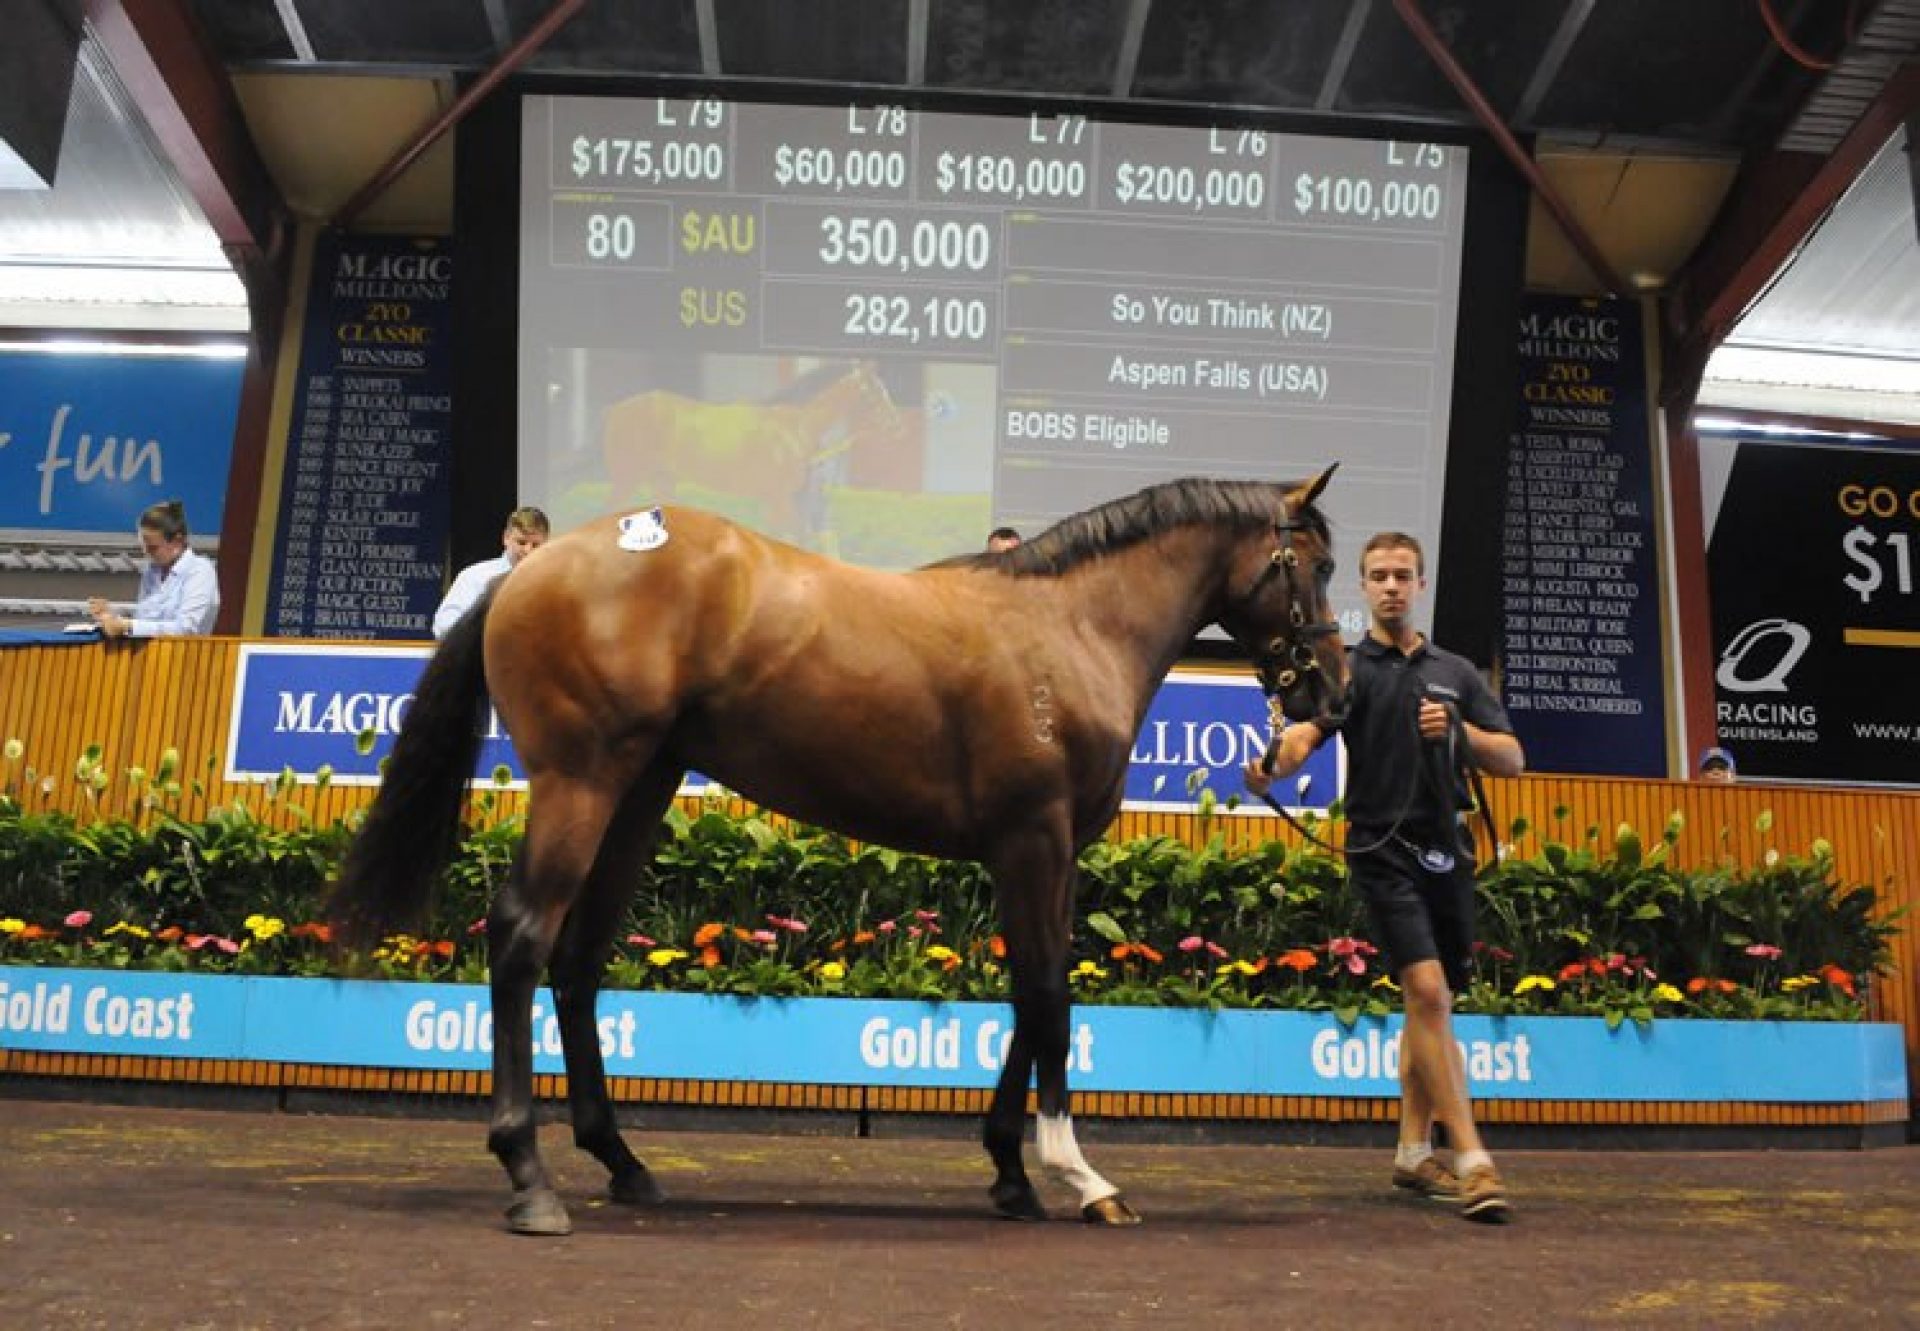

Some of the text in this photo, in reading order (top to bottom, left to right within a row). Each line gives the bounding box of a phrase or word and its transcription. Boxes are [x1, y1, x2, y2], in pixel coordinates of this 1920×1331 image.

[571, 135, 723, 184] $175,000
[774, 144, 905, 192] $60,000
[936, 151, 1085, 200] $180,000
[1115, 162, 1264, 210] $200,000
[1294, 173, 1441, 220] $100,000
[586, 214, 636, 260] 80
[681, 210, 756, 254] $AU
[819, 217, 990, 272] 350,000
[337, 253, 451, 282] MAGIC
[680, 287, 747, 329] $US
[844, 295, 987, 343] 282,100
[1112, 294, 1332, 338] So You Think (NZ)
[1519, 314, 1619, 343] MAGIC
[341, 348, 426, 366] WINNERS
[1108, 356, 1328, 398] Aspen Falls (USA)
[1007, 411, 1170, 449] BOBS Eligible
[36, 404, 163, 516] fun
[1839, 484, 1898, 517] GO
[1842, 525, 1912, 603] $1
[1717, 701, 1816, 725] RACING
[1718, 726, 1819, 743] QUEENSLAND
[84, 986, 194, 1040] Coast
[860, 1017, 961, 1069] Gold
